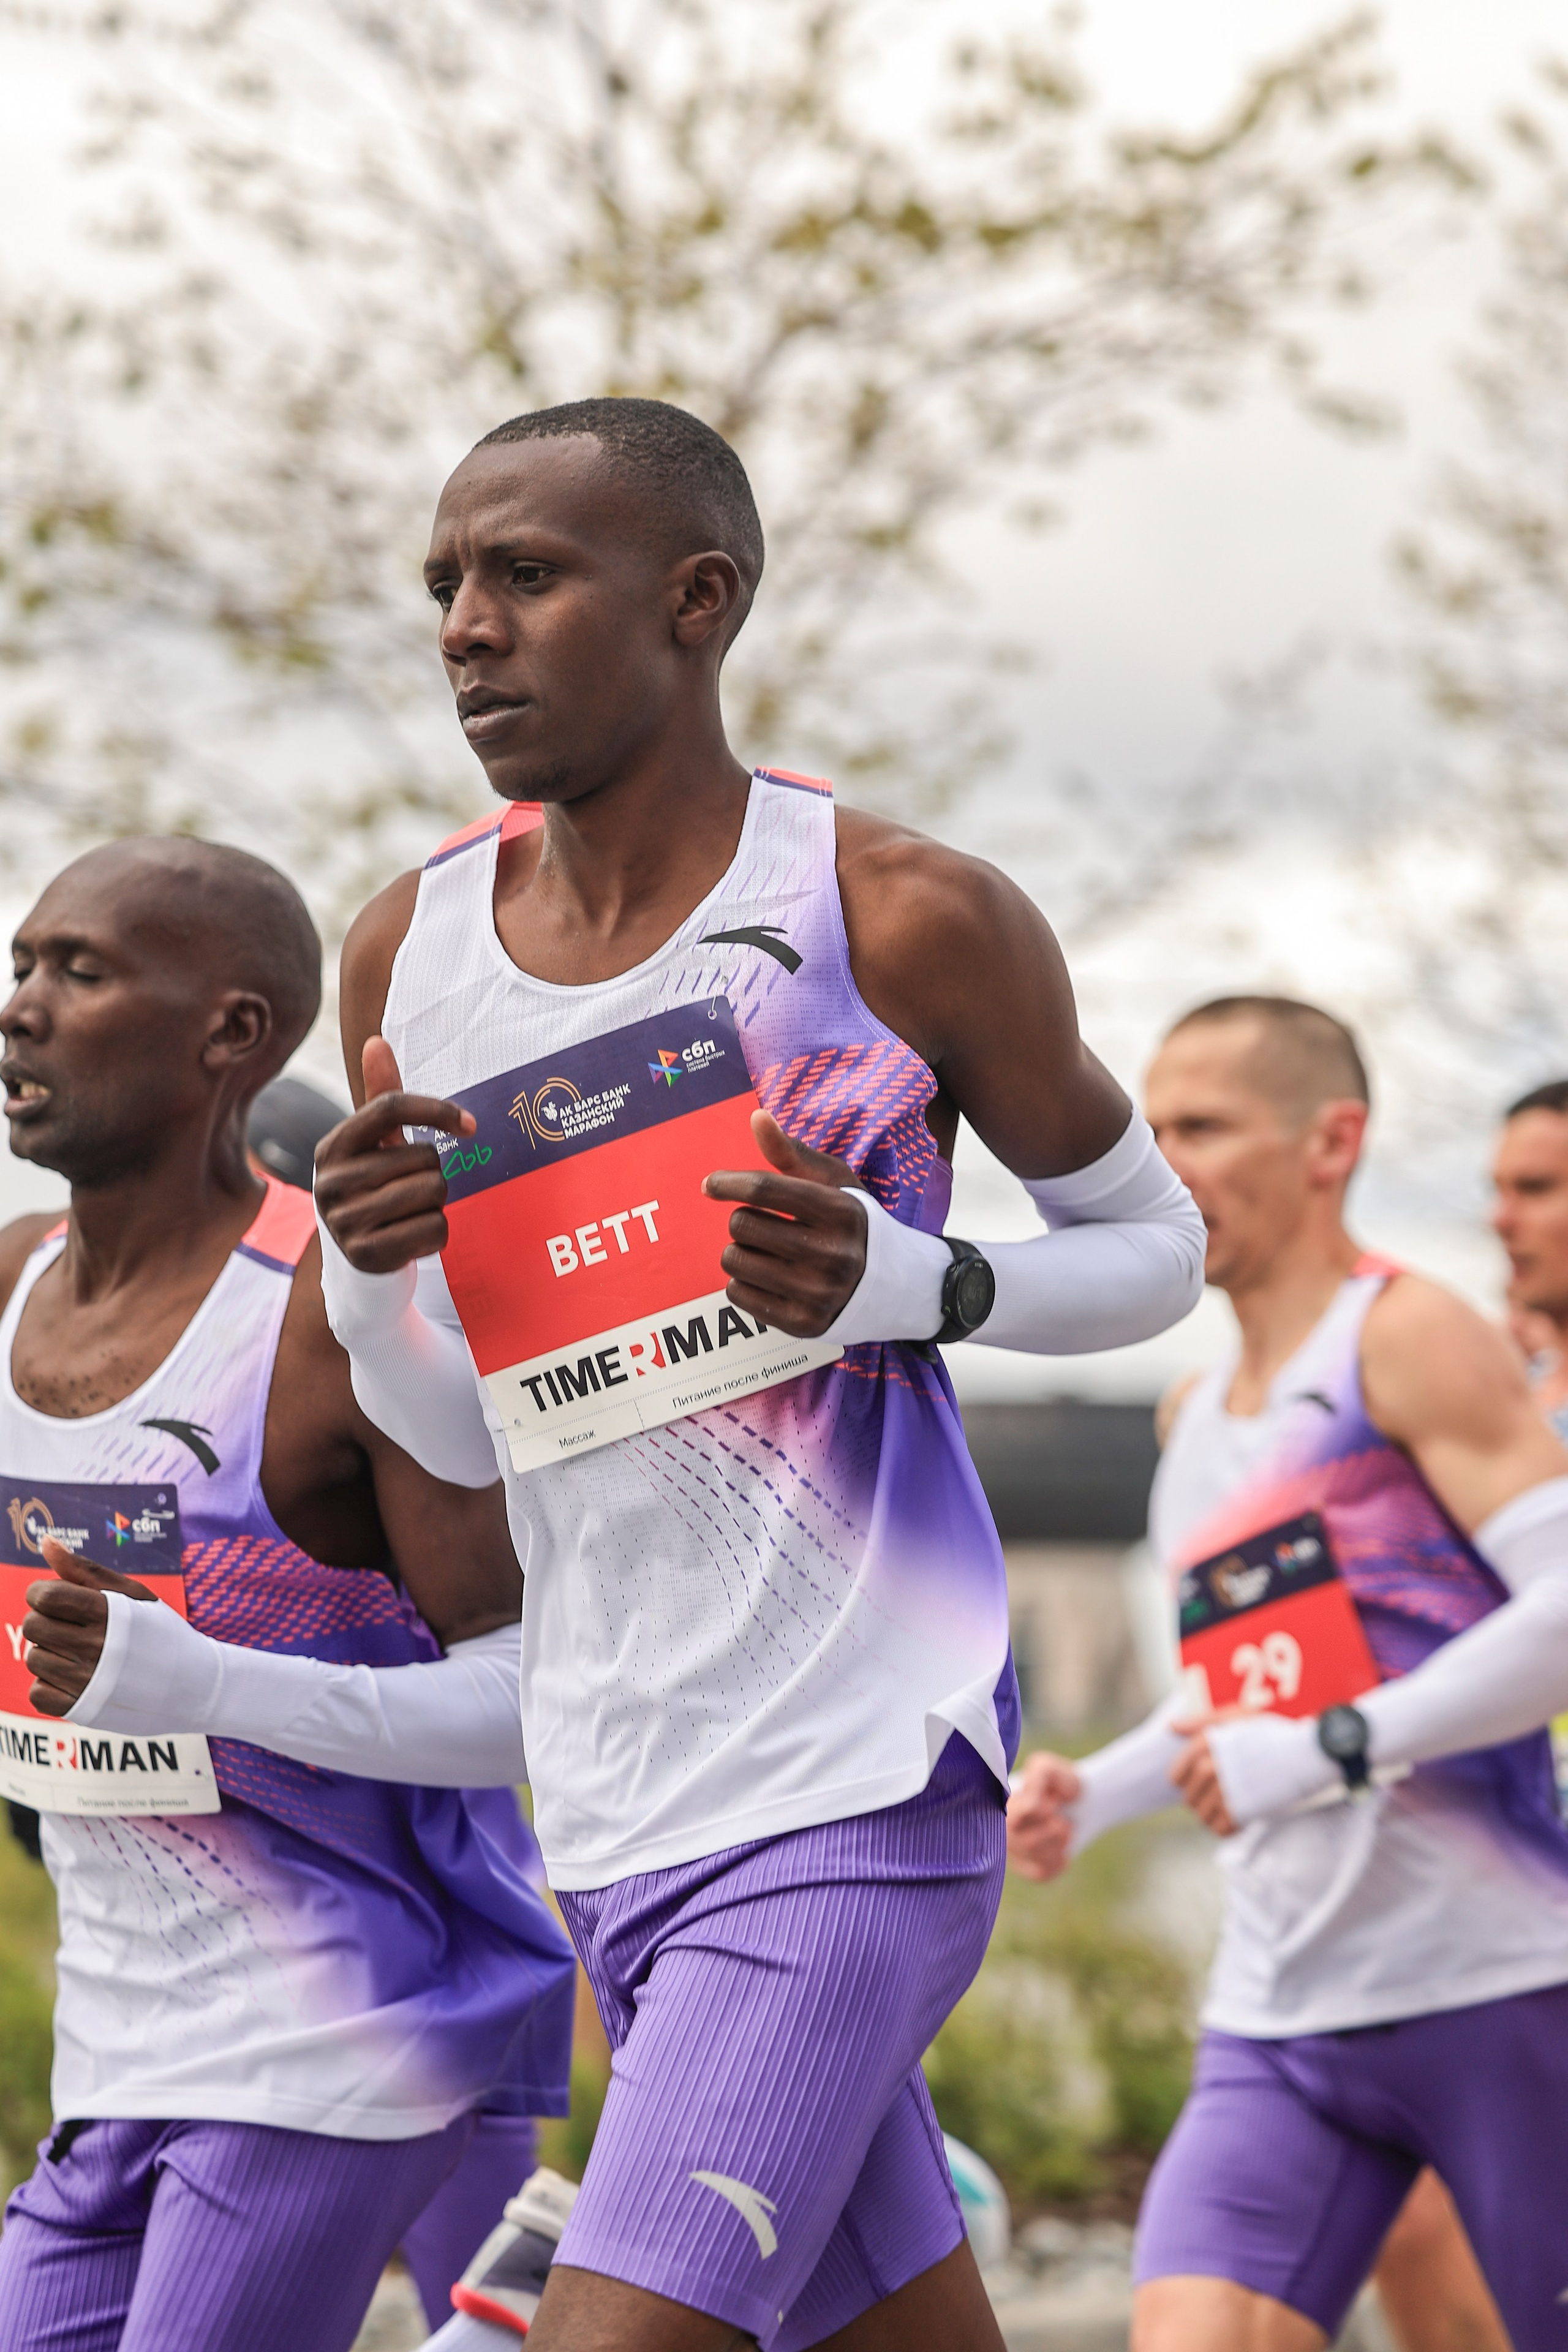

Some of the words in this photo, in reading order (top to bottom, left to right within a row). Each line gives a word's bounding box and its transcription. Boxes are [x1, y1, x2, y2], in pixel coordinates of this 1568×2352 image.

[682, 1039, 716, 1061] сбп
[508, 1077, 581, 1150] 10
[559, 1104, 573, 1119] АК
[574, 1094, 601, 1112] БАРС
[601, 1083, 631, 1102] БАНК
[561, 1097, 625, 1129] КАЗАНСКИЙ
[564, 1111, 616, 1139] МАРАФОН
[435, 1137, 459, 1155] Банк
[545, 1199, 660, 1278] BETT
[519, 1305, 769, 1412] TIMERMA
[672, 1385, 722, 1409] Питание
[723, 1371, 759, 1392] после
[761, 1354, 809, 1380] финиша
[559, 1429, 596, 1450] Массаж
[132, 1517, 160, 1532] сбп
[1230, 1630, 1303, 1708] 29
